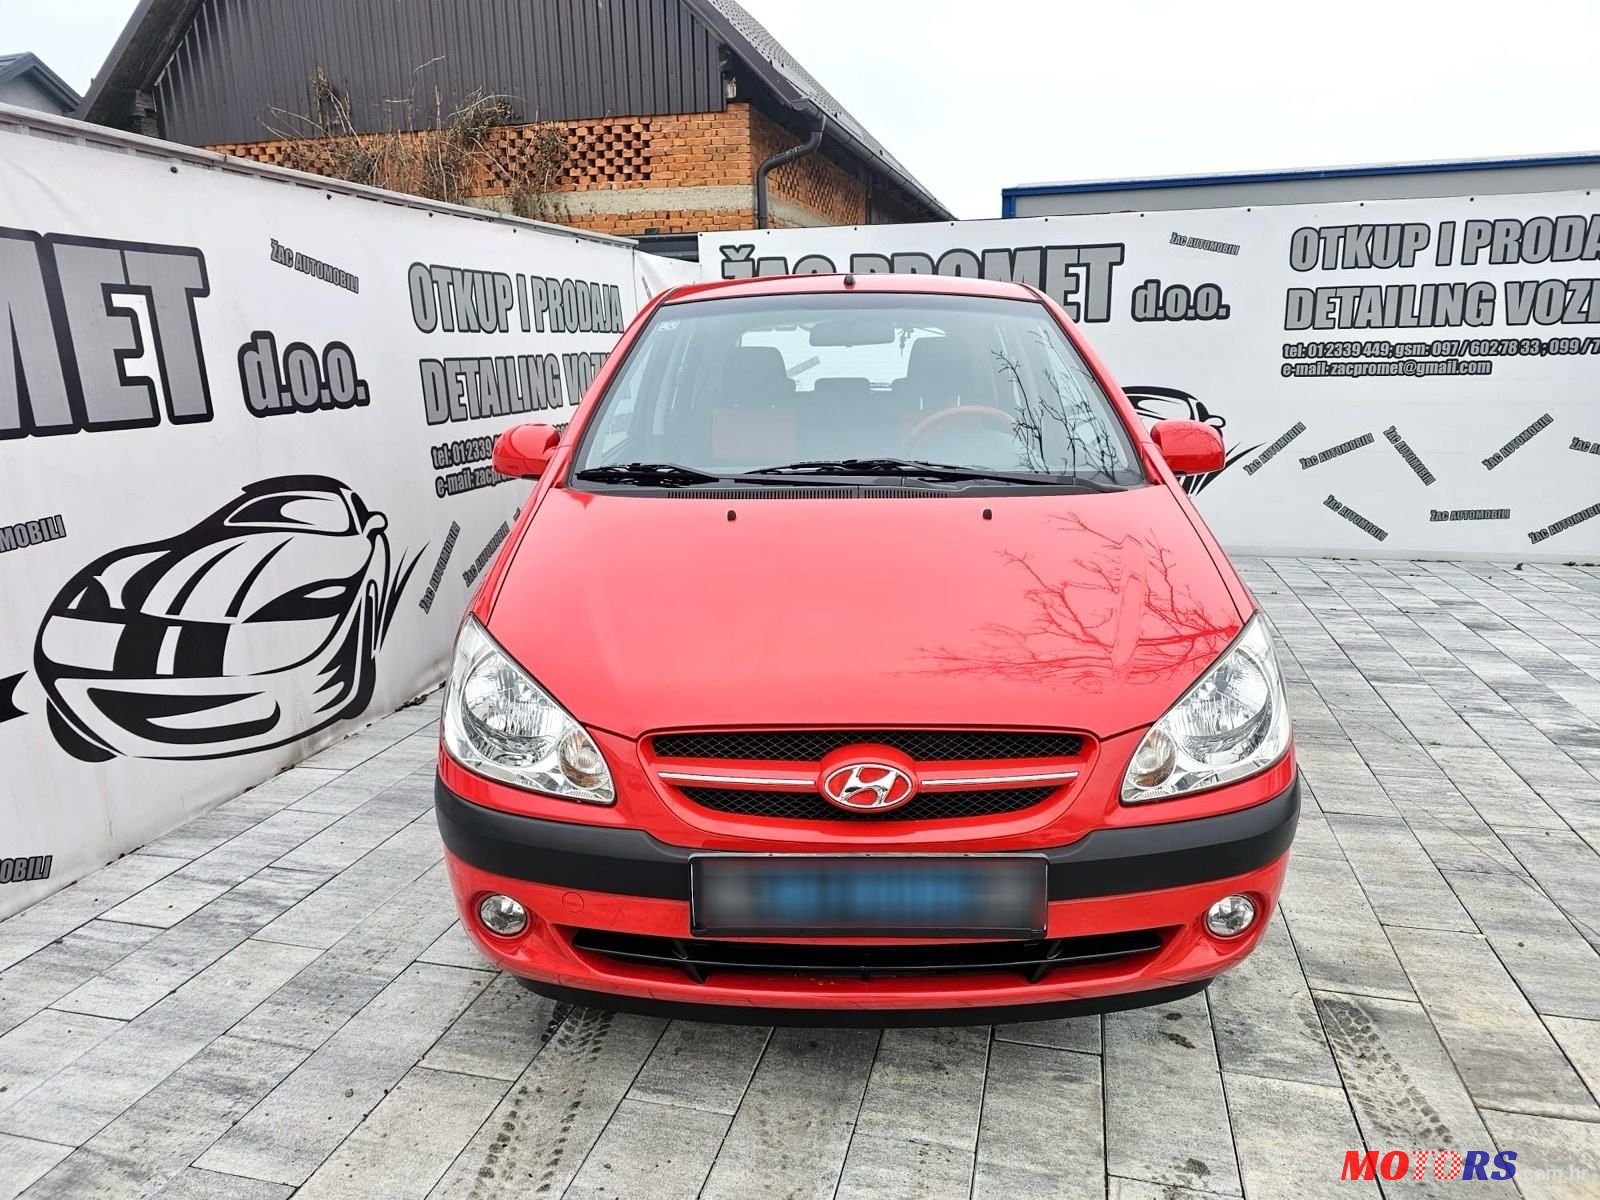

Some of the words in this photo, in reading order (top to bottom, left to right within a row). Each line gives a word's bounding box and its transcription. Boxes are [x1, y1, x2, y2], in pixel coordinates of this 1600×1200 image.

[1186, 237, 1240, 256] AUTOMOBILI
[1289, 223, 1431, 272] OTKUP
[1435, 220, 1457, 267] I
[294, 251, 359, 294] AUTOMOBILI
[408, 262, 514, 334] OTKUP
[516, 273, 531, 332] I
[530, 275, 625, 334] PRODAJA
[1131, 279, 1230, 322] d.o.o.
[1284, 281, 1497, 330] DETAILING
[1281, 361, 1332, 377] e-mail:
[1329, 359, 1493, 378] zacpromet@gmail.com
[1283, 342, 1306, 359] tel:
[1394, 342, 1431, 358] gsm:
[238, 330, 370, 418] d.o.o.
[419, 354, 563, 426] DETAILING
[430, 443, 453, 470] tel:
[1259, 421, 1307, 465] AUTOMOBILI
[1318, 432, 1375, 463] AUTOMOBILI
[1499, 413, 1554, 458] AUTOMOBILI
[435, 467, 475, 498] e-mail:
[1394, 440, 1436, 486] AUTOMOBILI
[1339, 505, 1388, 542] AUTOMOBILI
[1449, 508, 1511, 521] AUTOMOBILI
